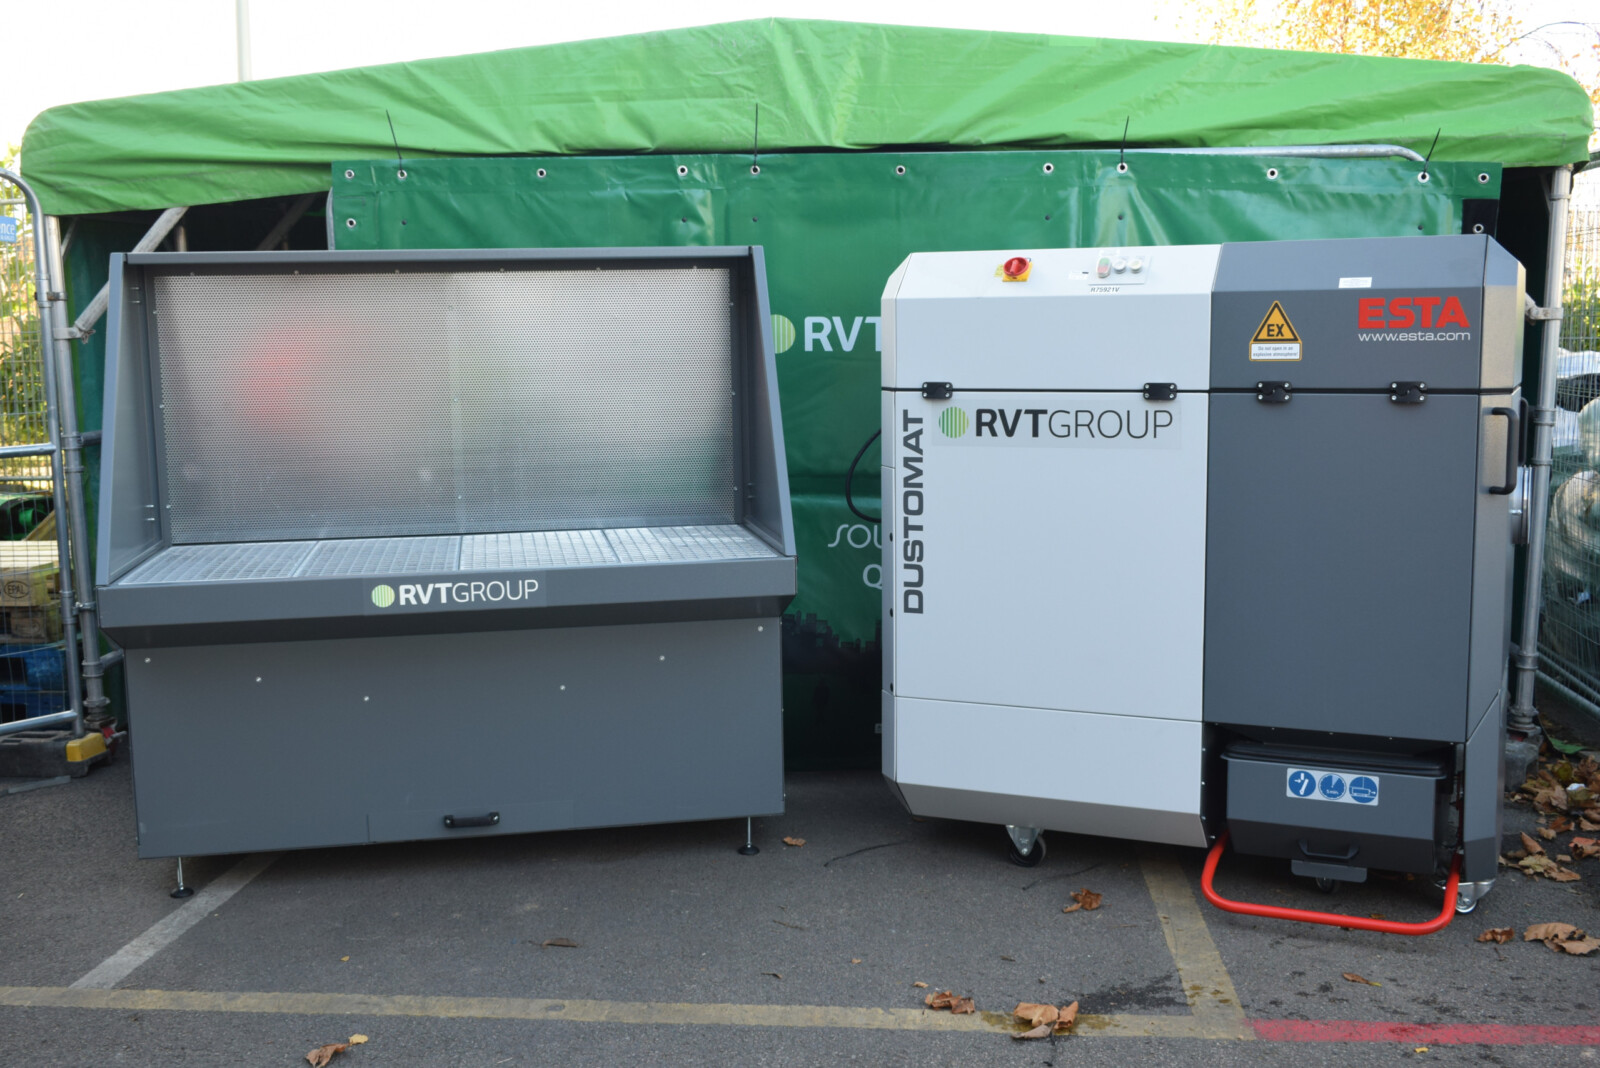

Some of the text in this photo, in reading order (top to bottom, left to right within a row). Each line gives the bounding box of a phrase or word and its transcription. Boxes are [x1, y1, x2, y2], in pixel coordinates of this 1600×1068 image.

[1358, 296, 1470, 329] ESTA
[1267, 323, 1285, 337] EX
[1358, 331, 1471, 342] www.esta.com
[975, 408, 1173, 439] RVTGROUP
[903, 409, 923, 614] DUSTOMAT
[8, 584, 25, 594] EPAL
[399, 579, 539, 606] RVTGROUP
